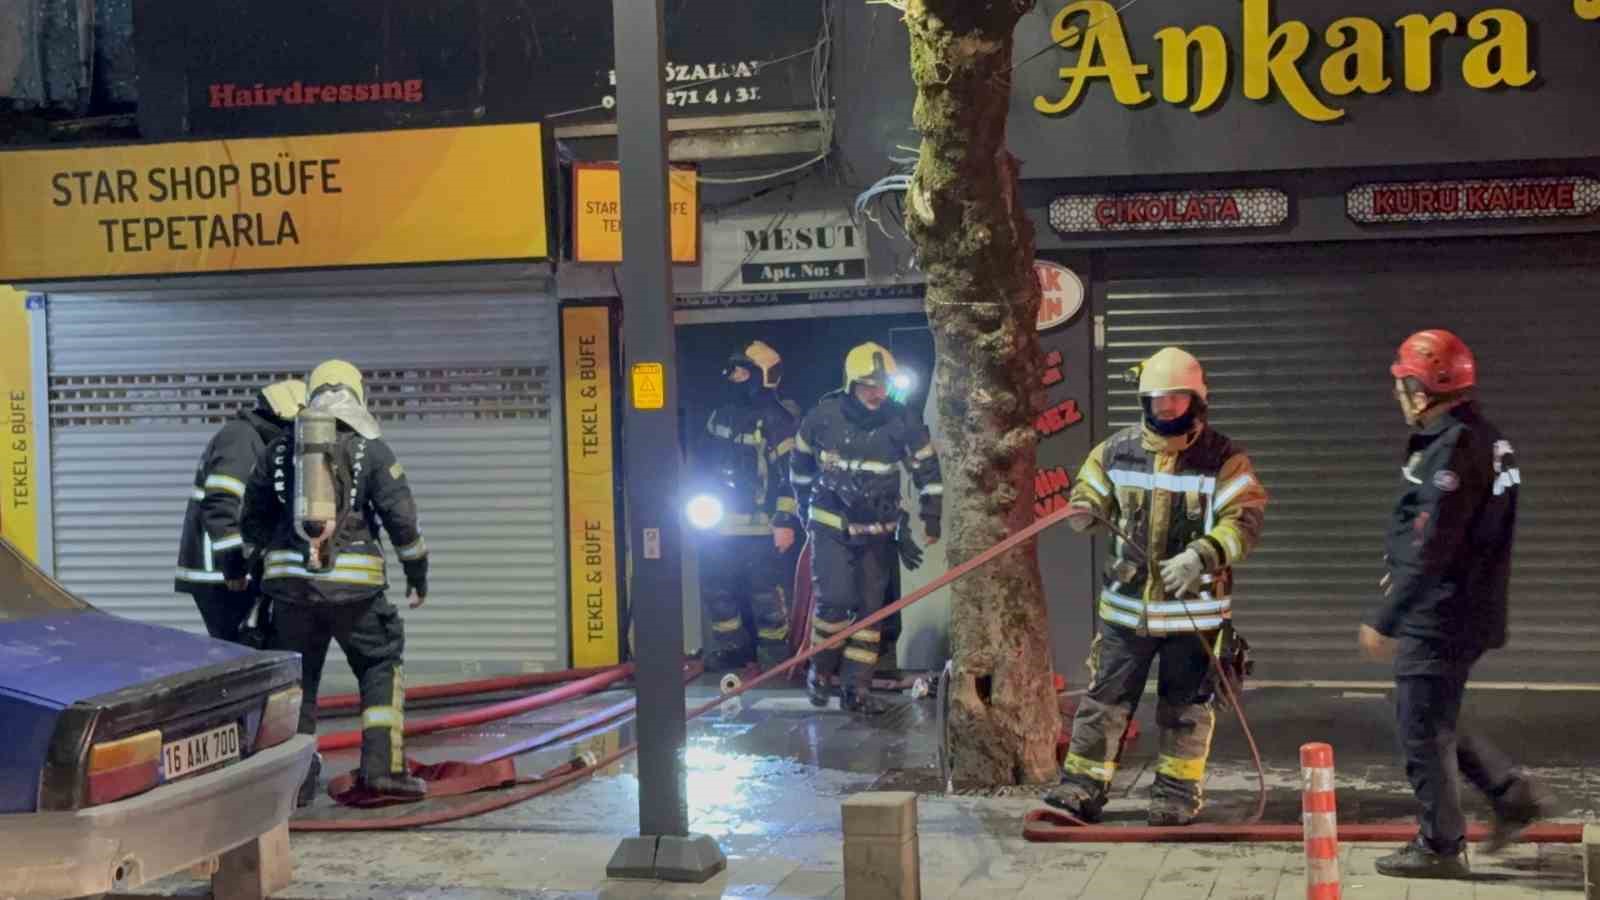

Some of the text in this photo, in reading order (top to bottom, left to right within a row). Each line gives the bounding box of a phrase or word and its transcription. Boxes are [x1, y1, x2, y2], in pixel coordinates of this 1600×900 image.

[1034, 0, 1536, 122] Ankara
[51, 152, 342, 207] STAR SHOP BÜFE
[1373, 184, 1574, 215] KURU KAHVE
[585, 201, 618, 215] STAR
[99, 210, 300, 253] TEPETARLA
[744, 225, 856, 252] MESUT
[760, 262, 845, 282] Apt. No: 4
[576, 335, 596, 380] BÜFE
[581, 403, 599, 458] TEKEL
[12, 454, 29, 508] TEKEL
[582, 520, 602, 564] BÜFE
[588, 588, 605, 643] TEKEL
[166, 727, 237, 775] 16 AAK 700
